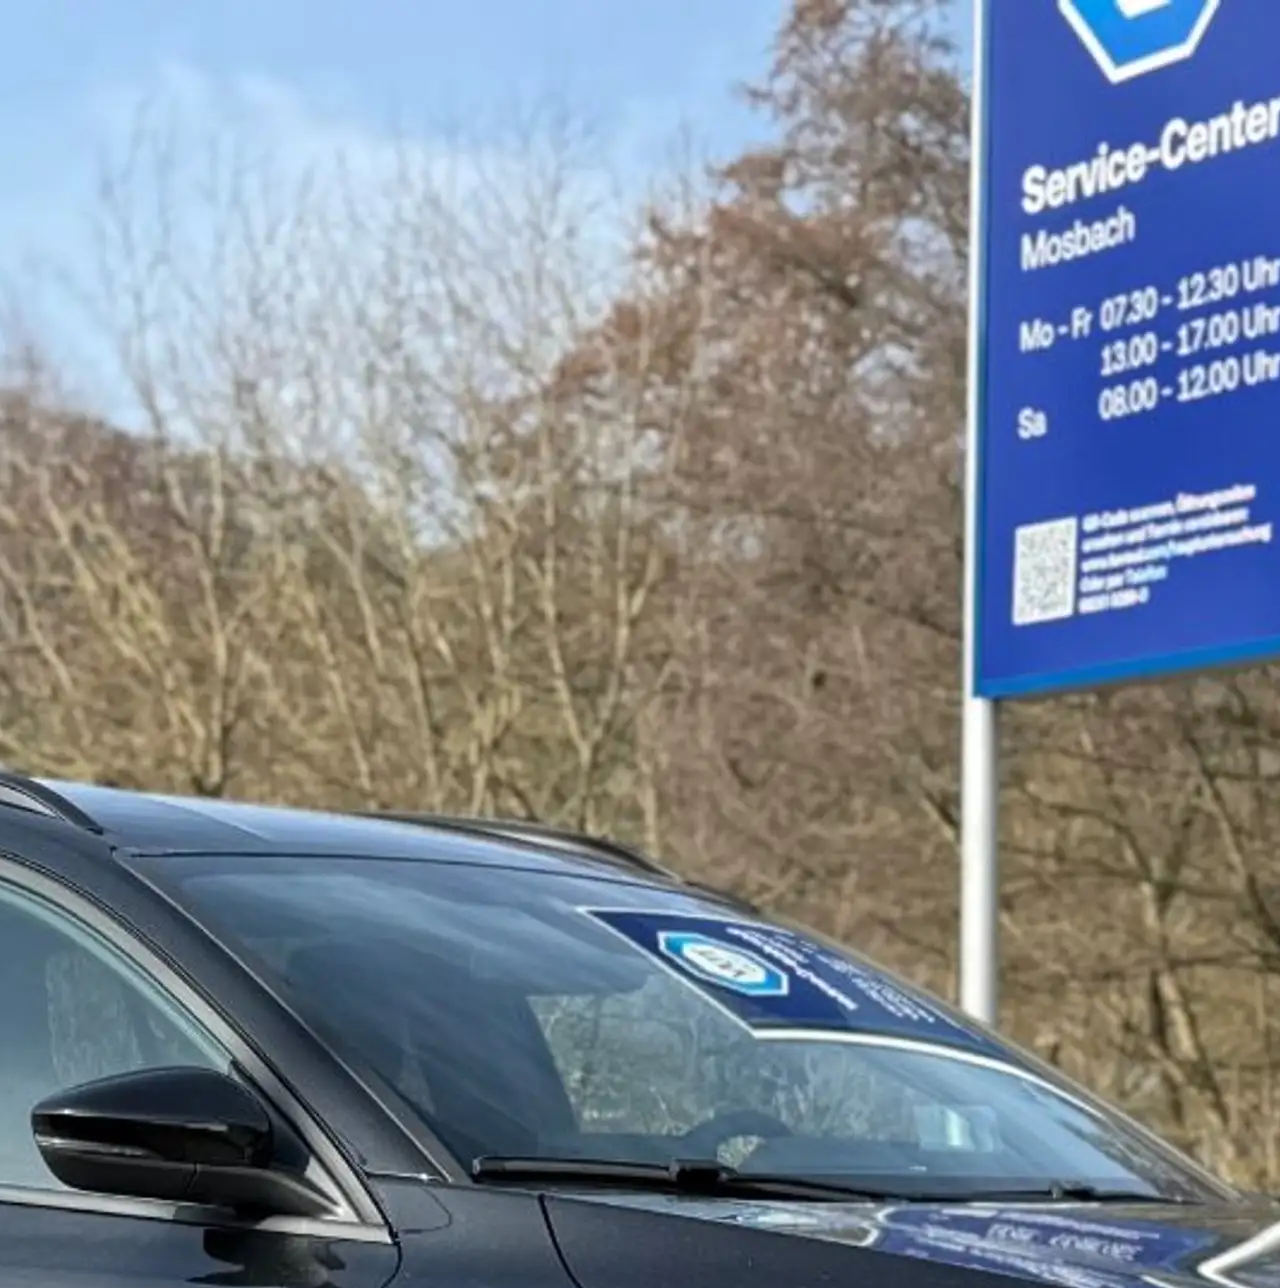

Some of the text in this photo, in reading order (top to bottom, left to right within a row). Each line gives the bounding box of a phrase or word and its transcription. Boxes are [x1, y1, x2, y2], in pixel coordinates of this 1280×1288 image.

[1020, 206, 1136, 271] Mosbach
[1019, 320, 1055, 352] Mo
[1071, 306, 1093, 339] Fr
[1100, 286, 1159, 331] 07.30
[1161, 296, 1173, 305] -
[1177, 264, 1240, 310] 12.30
[1100, 332, 1158, 376] 13.00
[1161, 341, 1173, 351] -
[1177, 312, 1240, 356] 17.00
[1017, 407, 1048, 440] Sa
[1098, 377, 1158, 420] 08.00
[1161, 387, 1173, 396] -
[1177, 357, 1240, 402] 12.00
